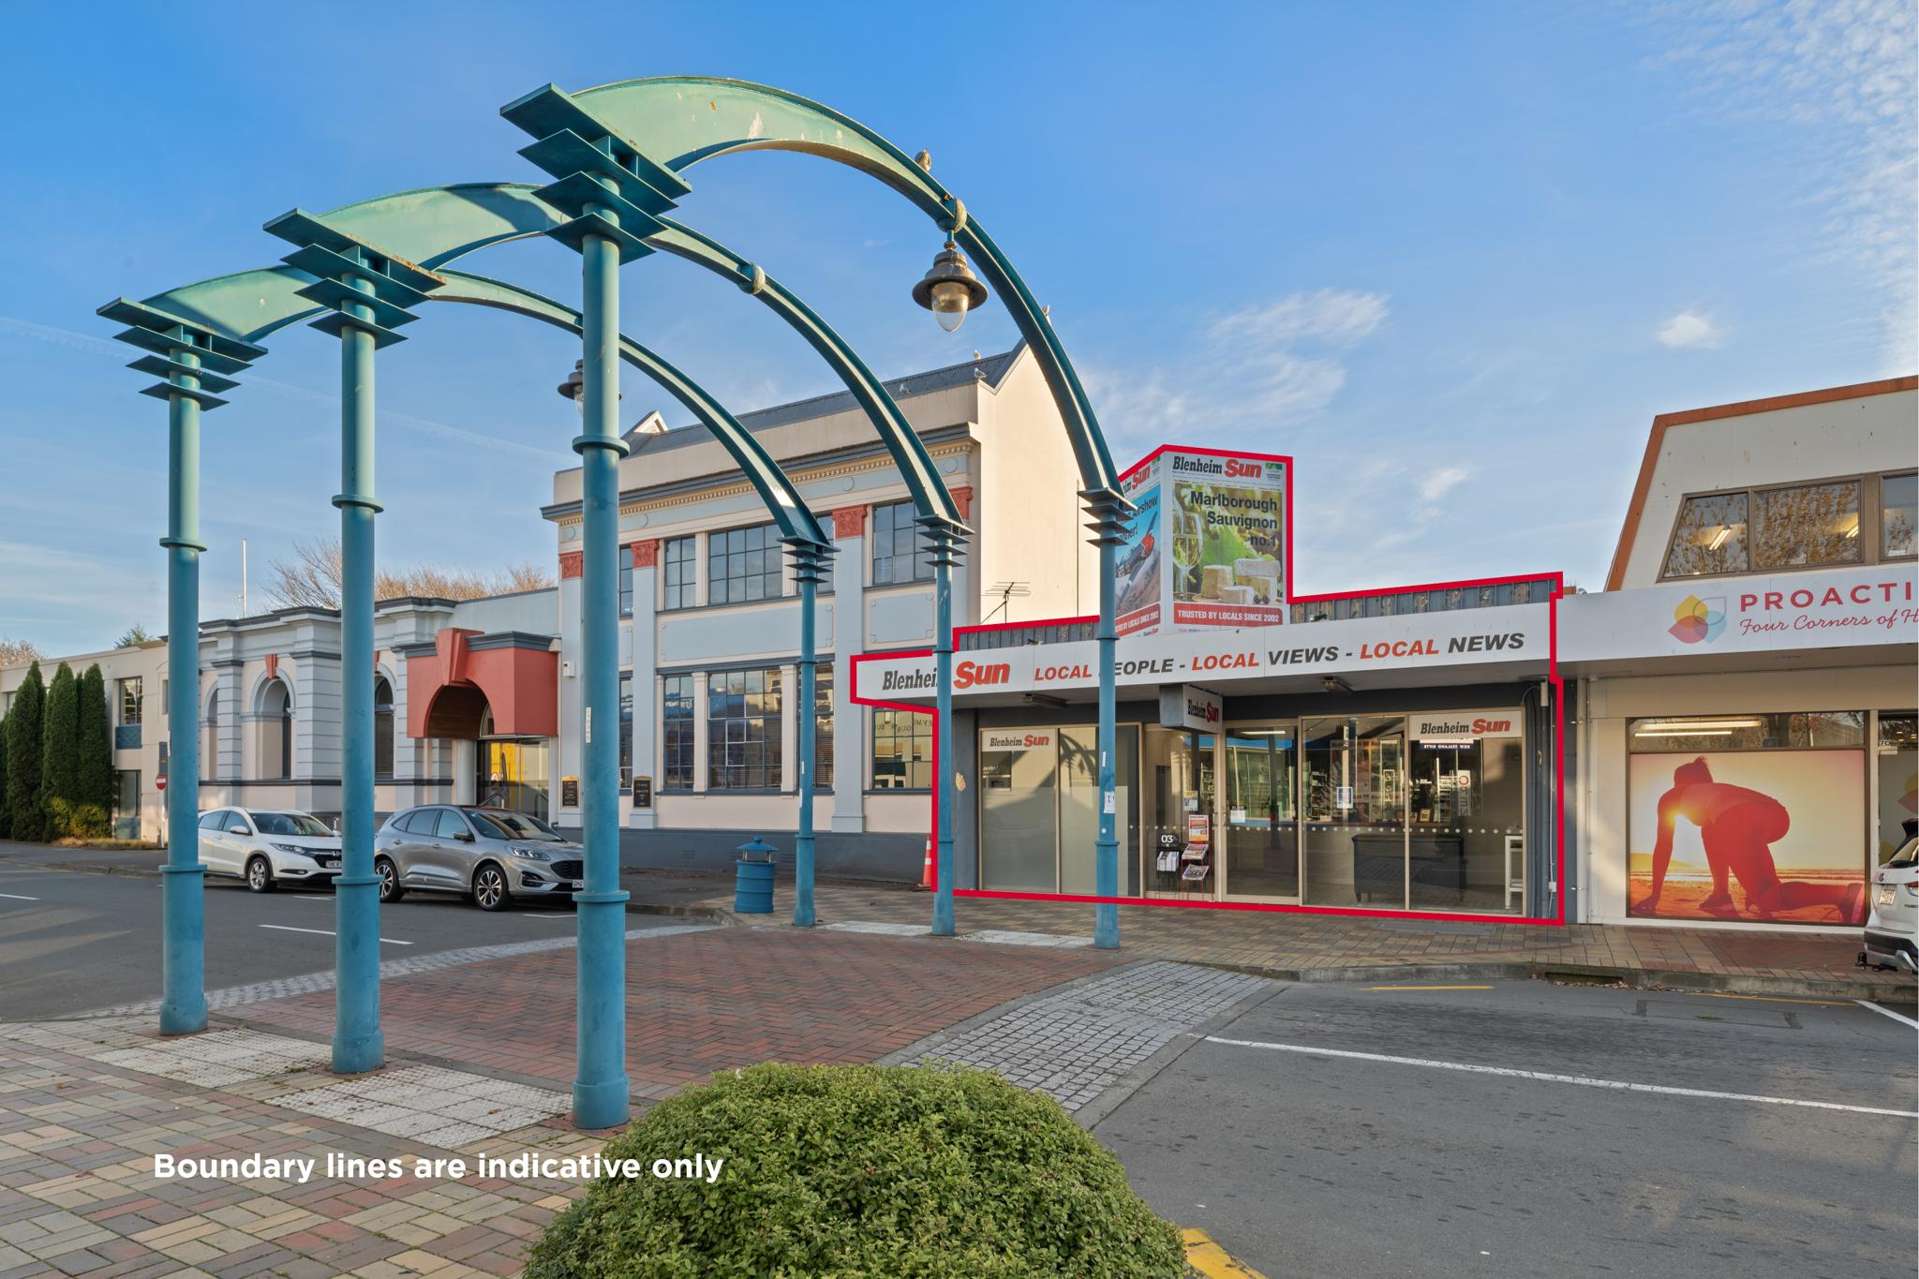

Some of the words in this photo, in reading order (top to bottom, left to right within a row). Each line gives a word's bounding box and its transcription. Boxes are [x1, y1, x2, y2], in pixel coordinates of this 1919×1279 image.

[1172, 456, 1222, 474] Blenheim
[1224, 459, 1262, 479] Sun
[1190, 491, 1277, 511] Marlborough
[1207, 511, 1277, 529] Sauvignon
[1250, 535, 1276, 546] no.1
[1177, 609, 1207, 619] TRUSTED
[1208, 610, 1217, 619] BY
[1218, 611, 1243, 621] LOCALS
[1243, 612, 1263, 622] SINCE
[1263, 613, 1280, 622] 2002
[1739, 618, 1790, 636] Four
[1793, 614, 1872, 630] Corners
[1876, 609, 1898, 630] of
[1034, 664, 1093, 681] LOCAL
[1113, 658, 1174, 676] EOPLE
[1191, 652, 1260, 671] LOCAL
[1268, 646, 1339, 666] VIEWS
[1360, 639, 1440, 660] LOCAL
[1448, 632, 1525, 654] NEWS
[882, 666, 937, 691] Blenhei
[953, 660, 1010, 690] Sun
[1206, 701, 1219, 723] Sun
[1420, 722, 1470, 734] Blenheim
[1471, 718, 1511, 734] Sun
[990, 736, 1022, 747] Blenheim
[1024, 734, 1049, 747] Sun
